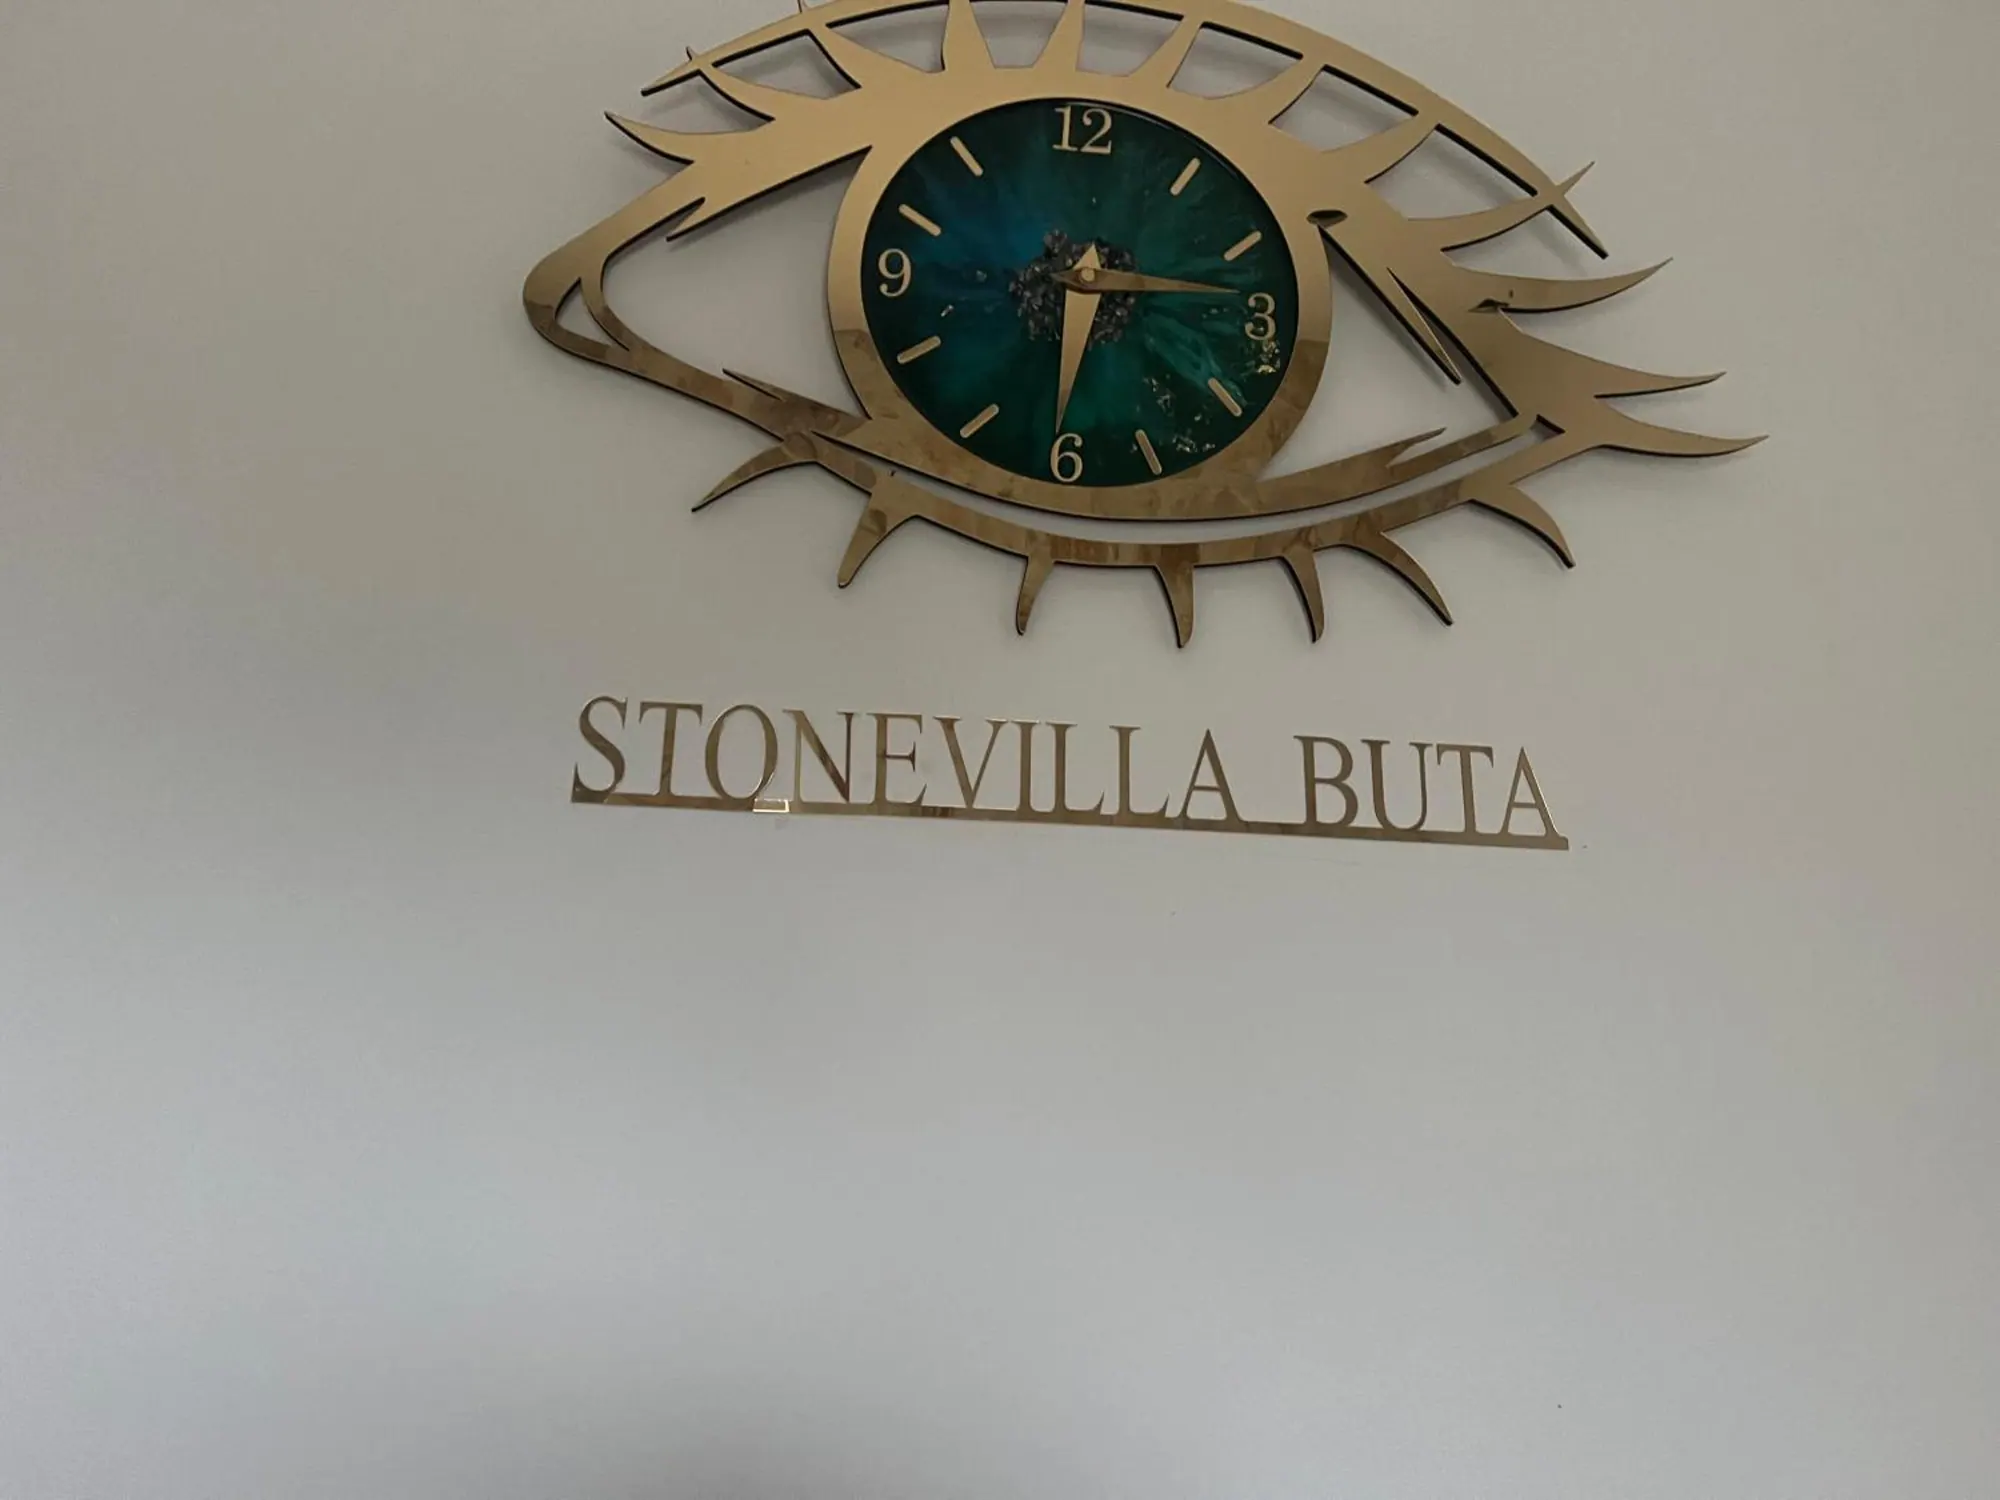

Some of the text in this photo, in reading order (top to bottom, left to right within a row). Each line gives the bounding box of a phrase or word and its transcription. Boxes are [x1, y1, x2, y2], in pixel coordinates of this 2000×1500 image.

[1051, 105, 1112, 155] 12
[877, 248, 912, 297] 9
[1243, 292, 1276, 341] 3
[1049, 432, 1083, 482] 6
[571, 695, 1569, 849] STONEVILLA BUTA
